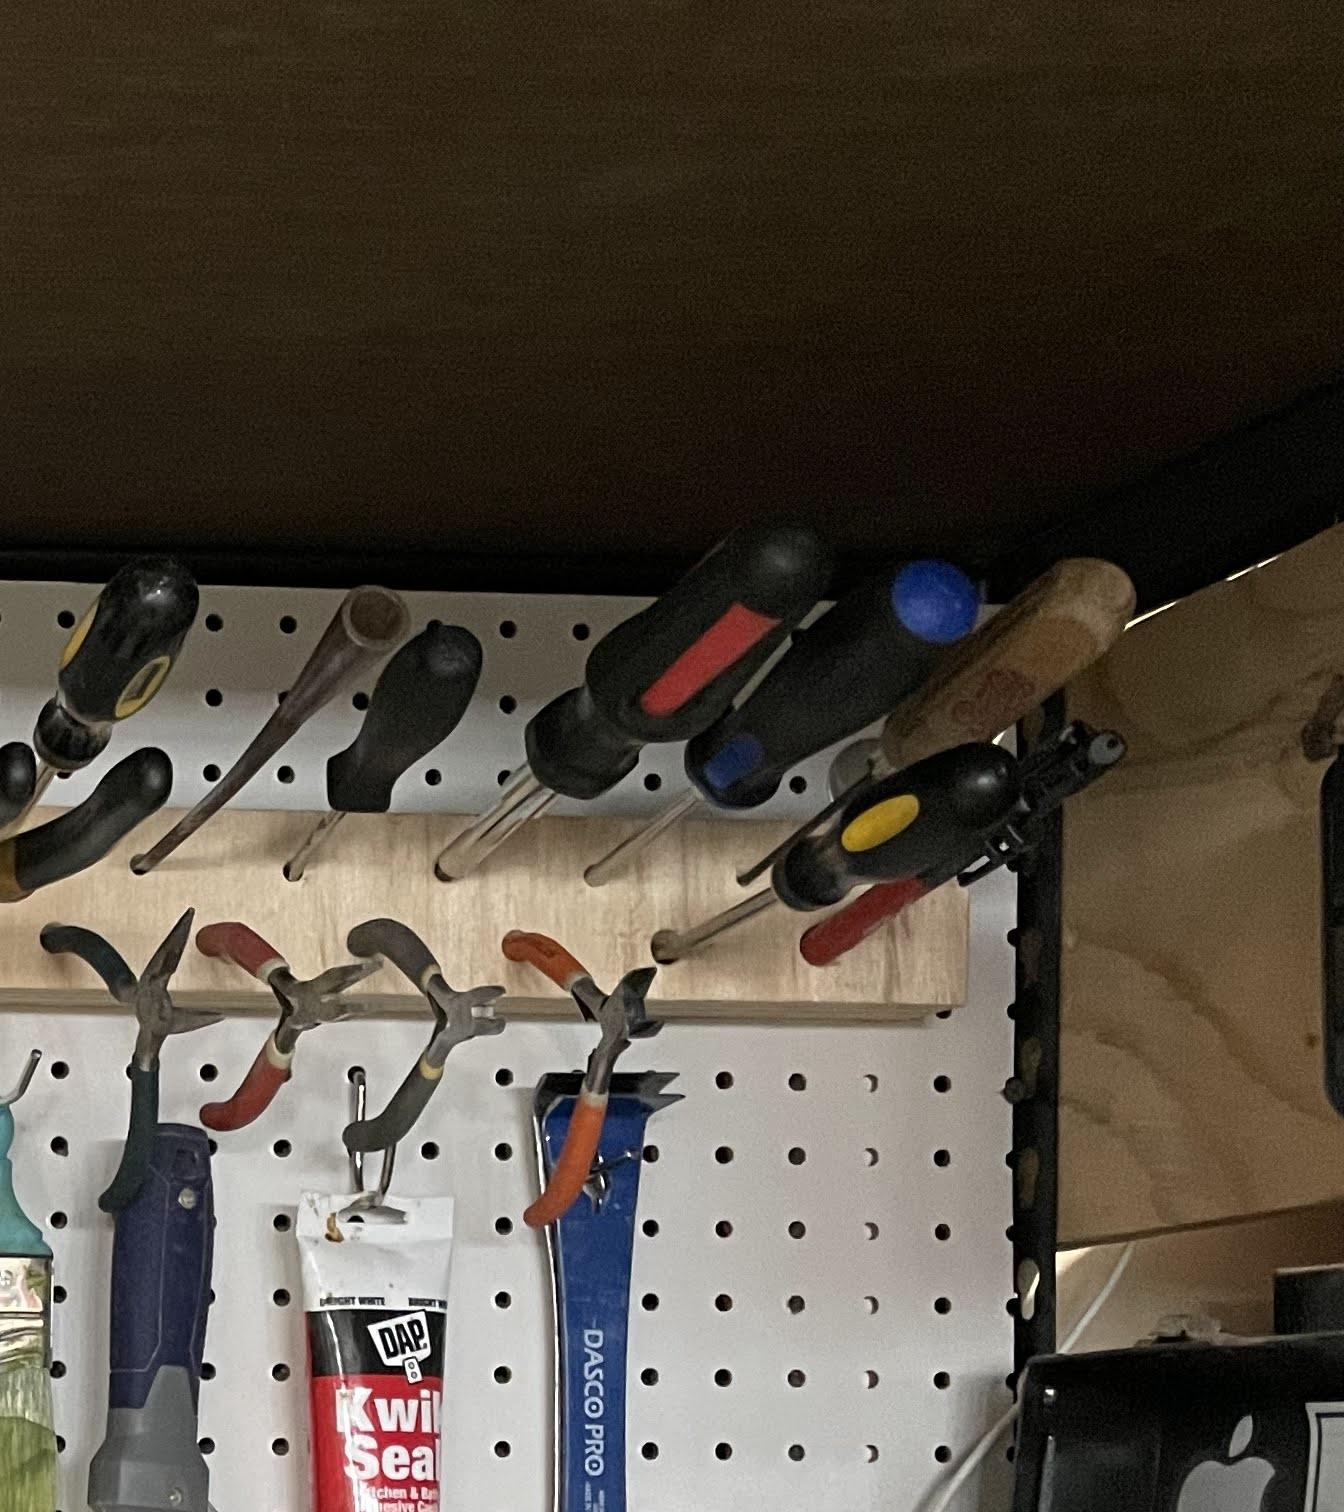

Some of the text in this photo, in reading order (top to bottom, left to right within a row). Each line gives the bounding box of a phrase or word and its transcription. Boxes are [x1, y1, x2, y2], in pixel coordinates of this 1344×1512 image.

[378, 1318, 426, 1360] DAP
[583, 1329, 604, 1419] DASCO
[583, 1424, 605, 1477] PRO
